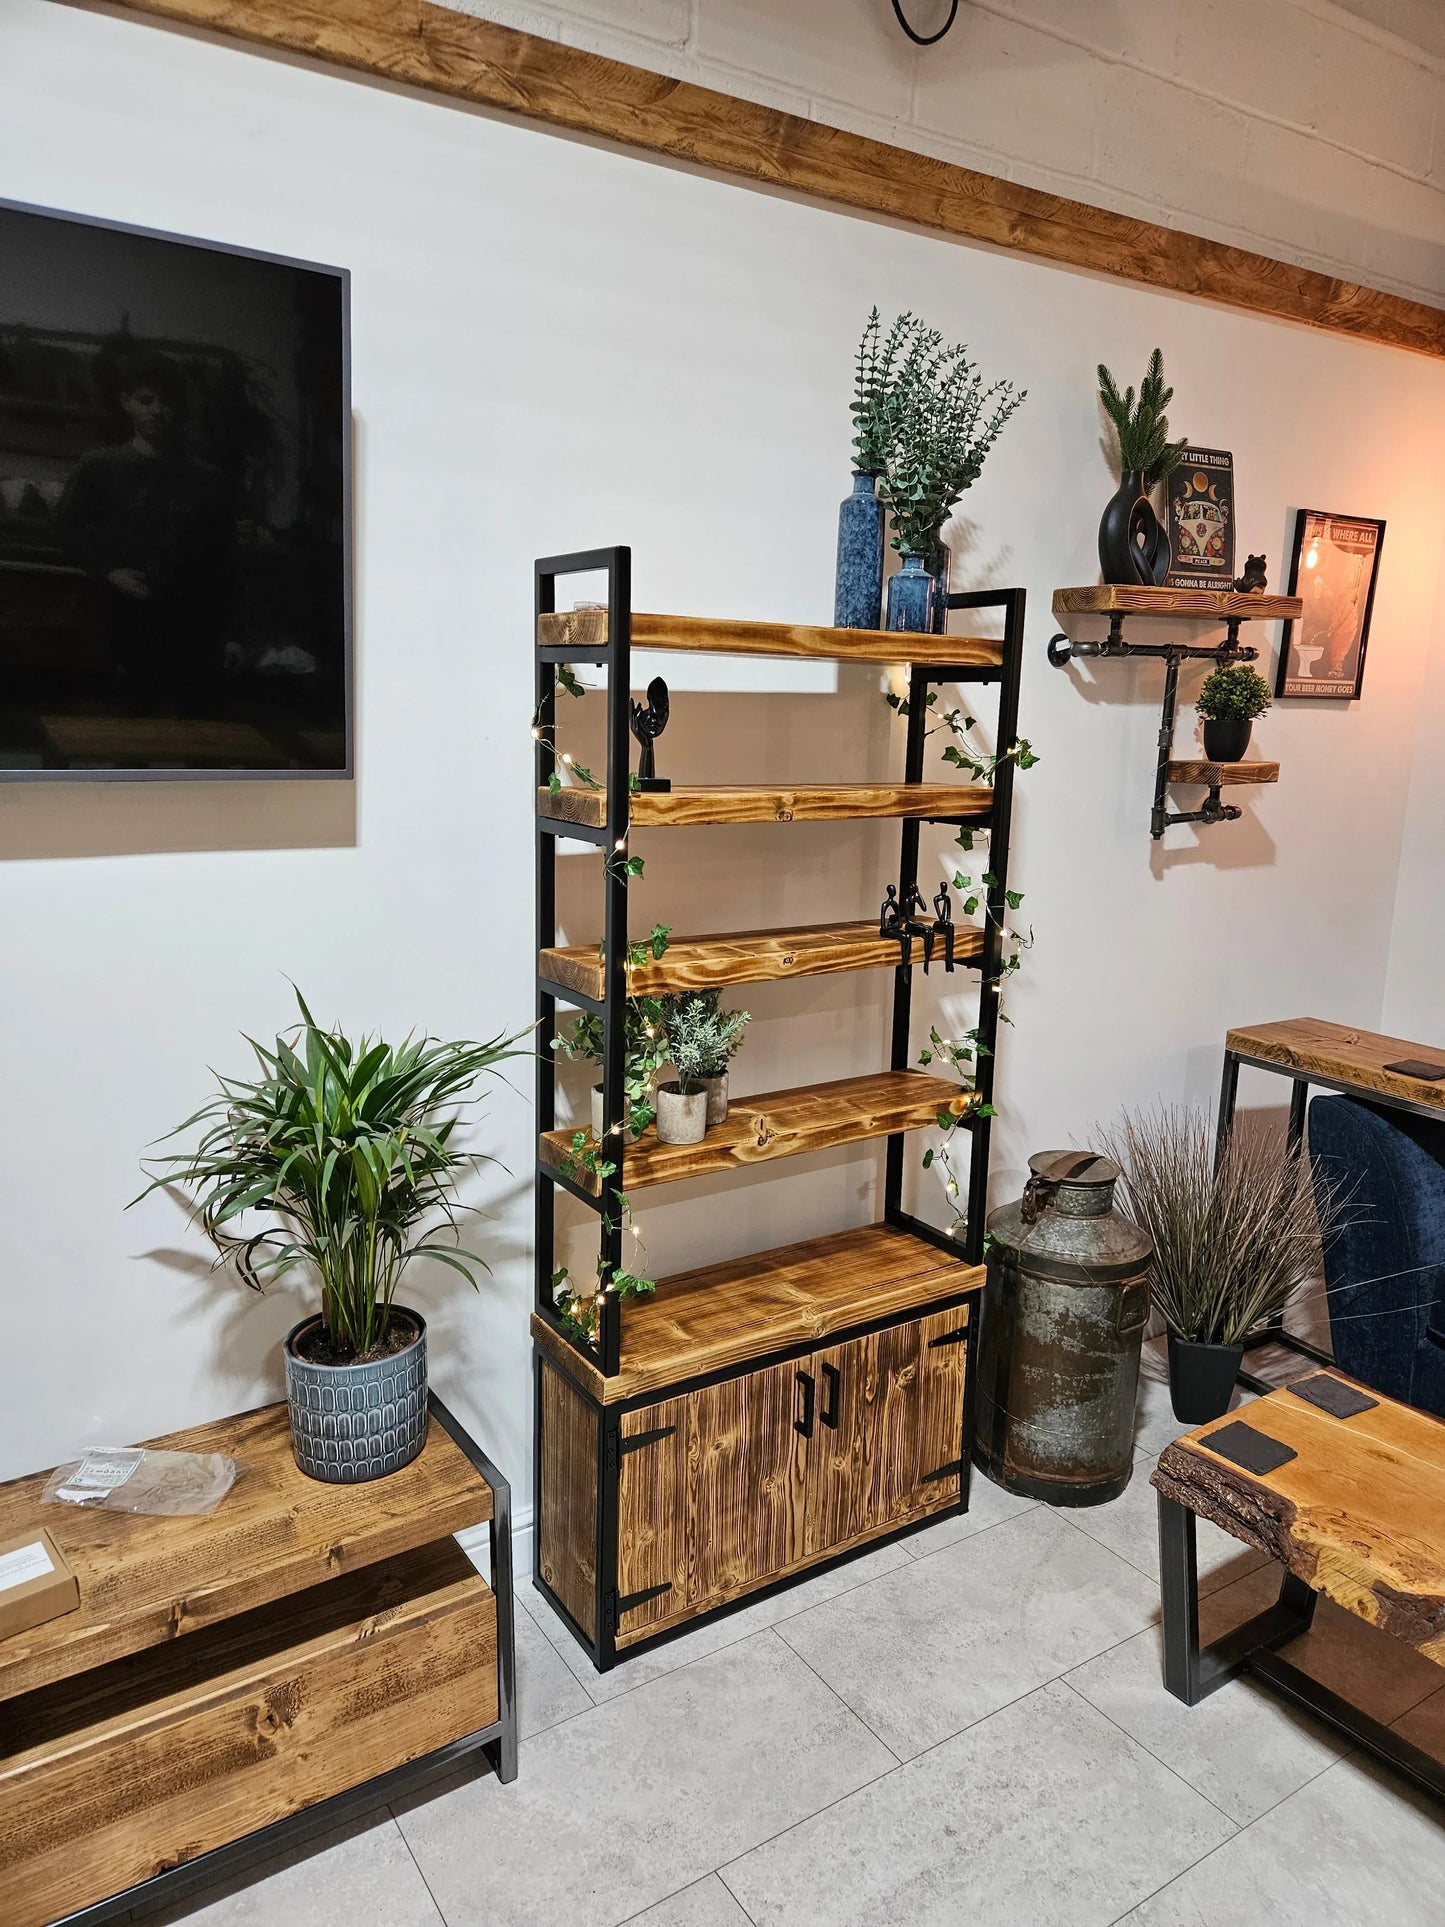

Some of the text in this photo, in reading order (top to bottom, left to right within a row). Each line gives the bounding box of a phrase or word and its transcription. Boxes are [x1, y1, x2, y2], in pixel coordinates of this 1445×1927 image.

[1189, 453, 1209, 464] LITTLE
[1210, 455, 1230, 466] THING
[1333, 528, 1359, 542] WHERE
[1359, 532, 1373, 543] ALL
[1175, 578, 1198, 588] GONNA
[1199, 580, 1206, 589] BE
[1206, 580, 1232, 590] ALRIGHT
[1285, 682, 1353, 694] YOUR BEER MONEY GOES
